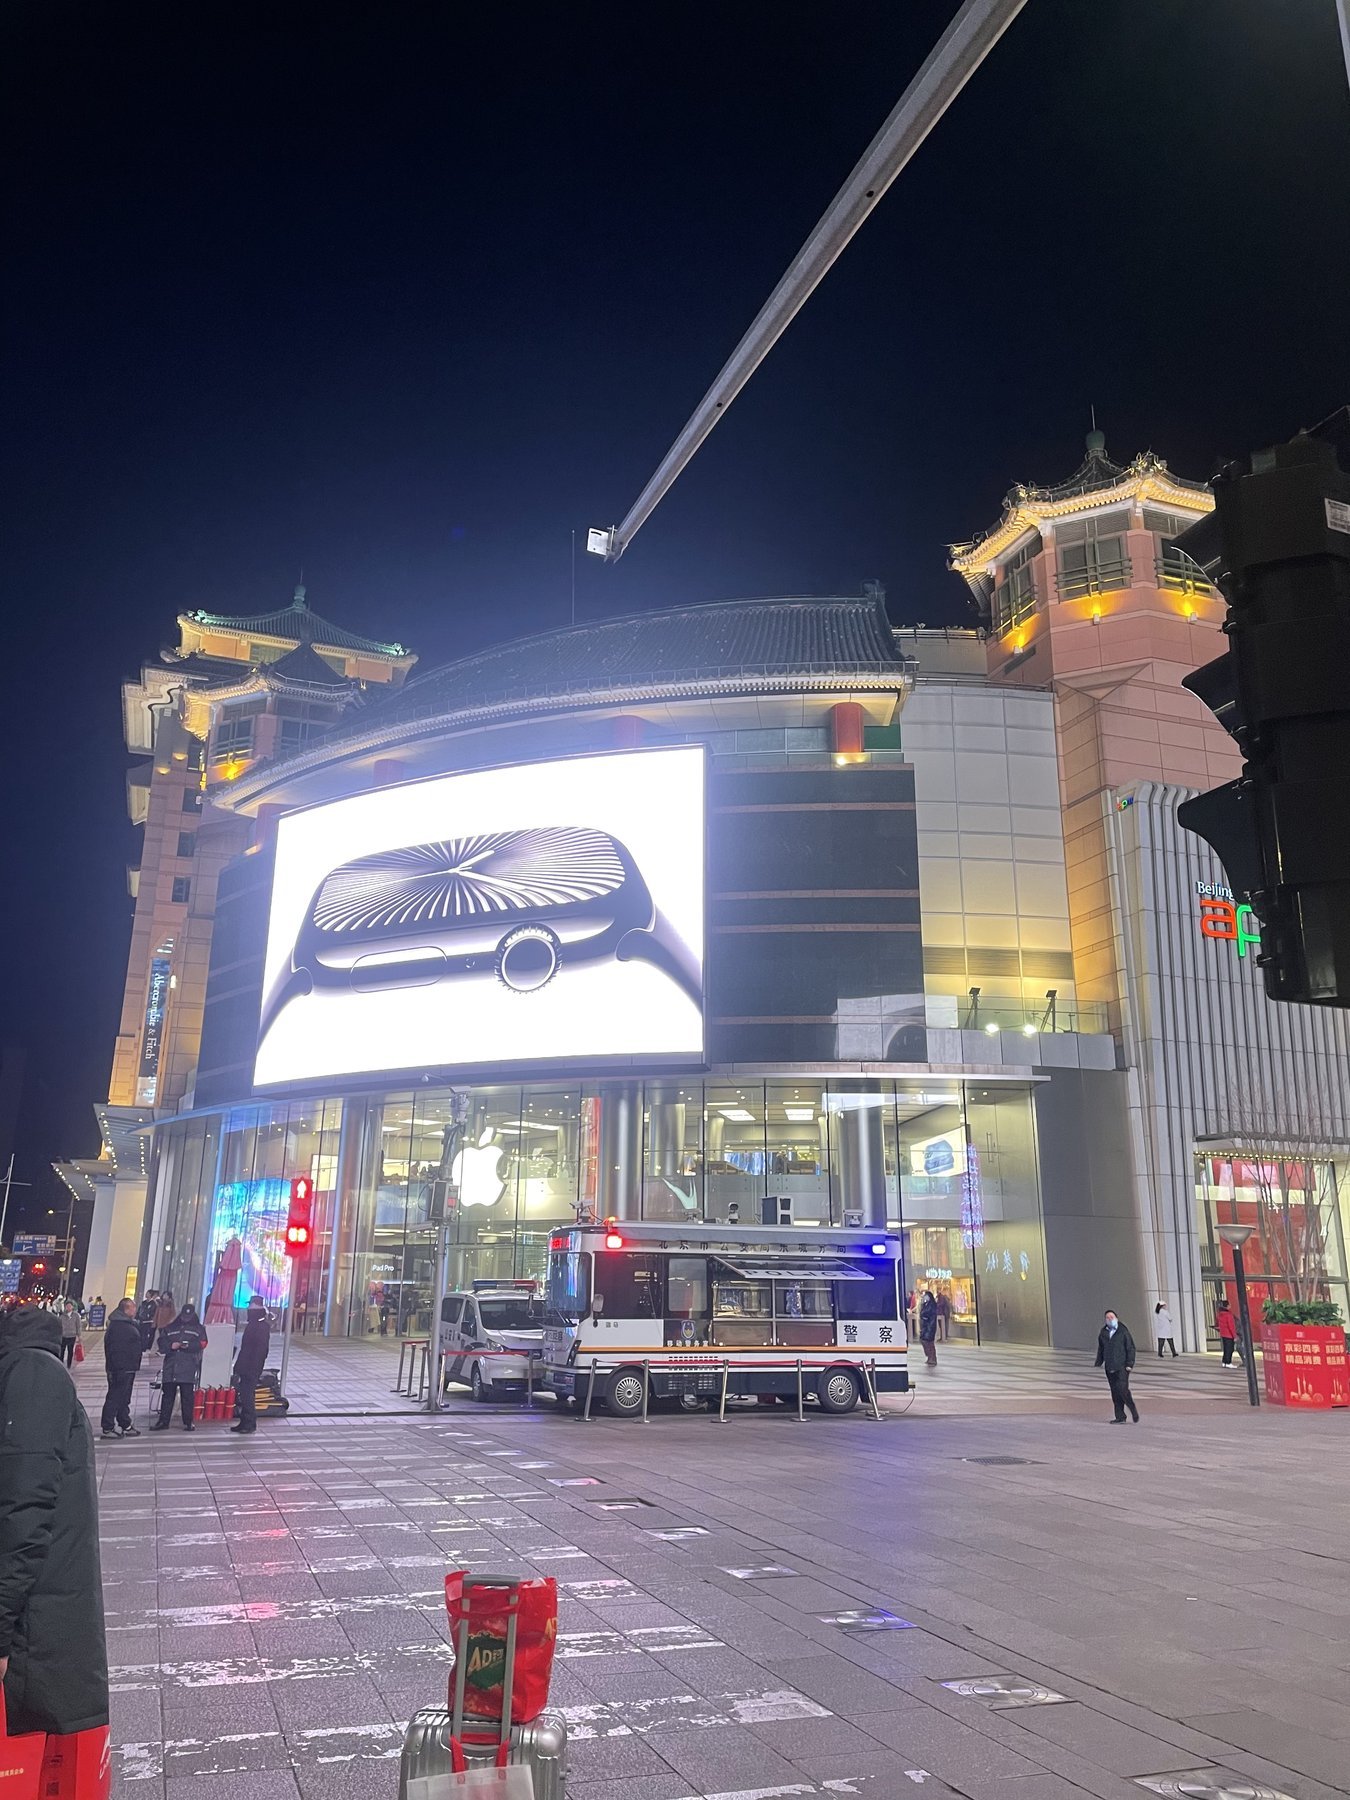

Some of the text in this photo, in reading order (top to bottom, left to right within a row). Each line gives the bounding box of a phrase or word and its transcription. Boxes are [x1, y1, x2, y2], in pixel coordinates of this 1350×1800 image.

[145, 973, 165, 1059] Abercrombie & Fitch
[384, 1264, 395, 1272] Pro
[844, 1324, 893, 1343] 警察
[1284, 1343, 1320, 1354] 京彩四季
